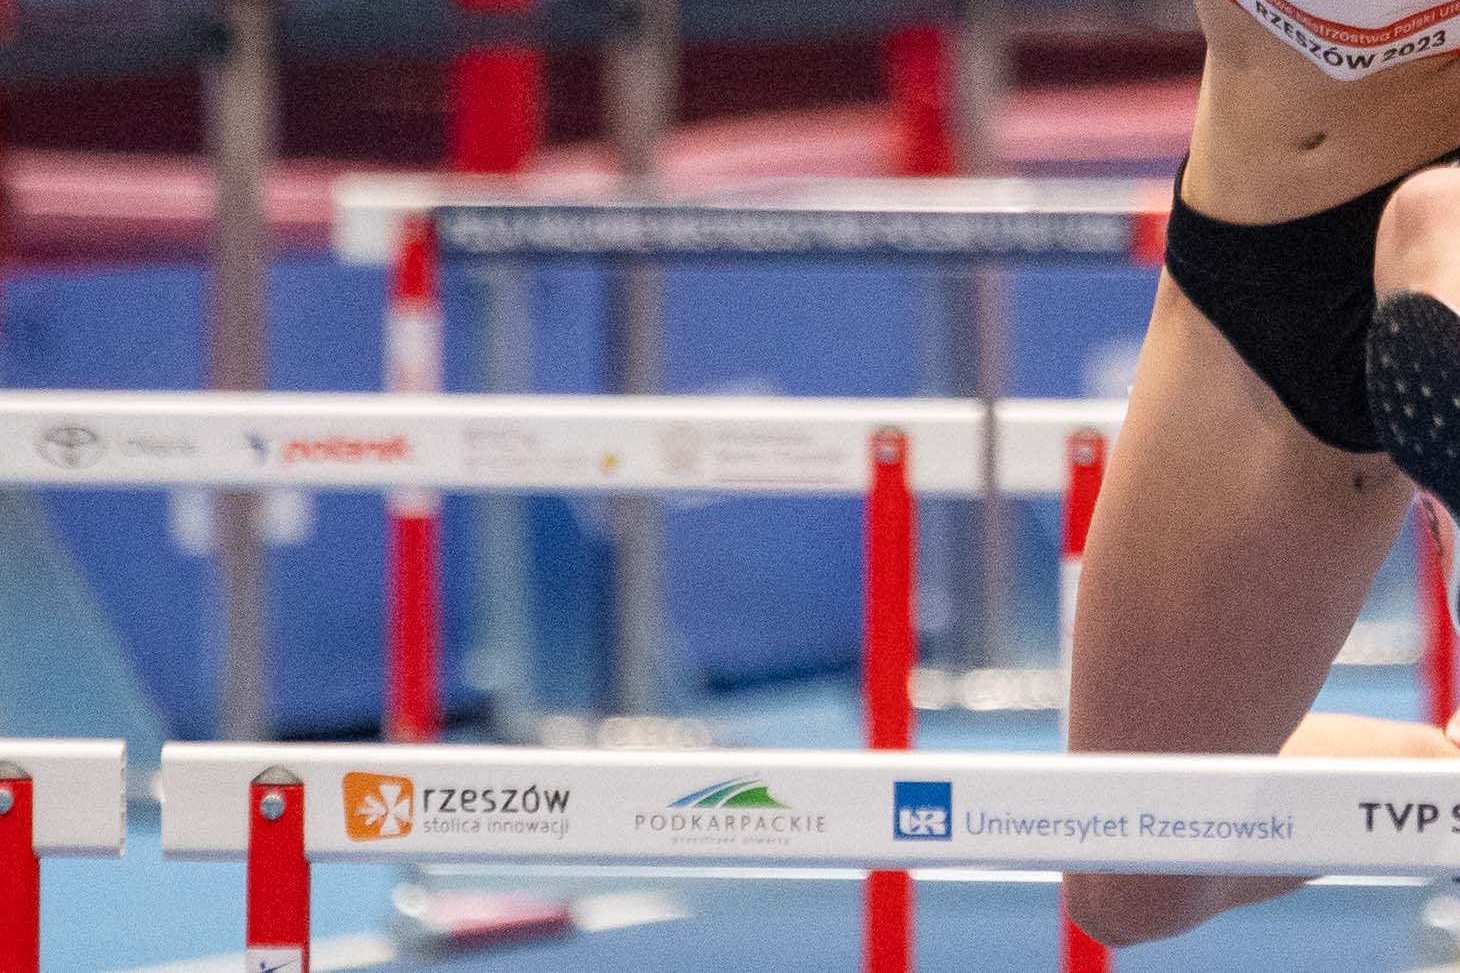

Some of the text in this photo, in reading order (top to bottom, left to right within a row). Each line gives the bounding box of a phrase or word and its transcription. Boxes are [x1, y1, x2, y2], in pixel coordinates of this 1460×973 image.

[1255, 0, 1447, 69] RZESZÓW 2023
[1394, 11, 1436, 37] Polski
[423, 784, 571, 814] rzeszów
[423, 817, 570, 840] stolica innowacji
[634, 814, 827, 833] PODKARPACKIE
[965, 810, 1294, 843] Uniwersytet Rzeszowski
[1358, 801, 1440, 833] TVP
